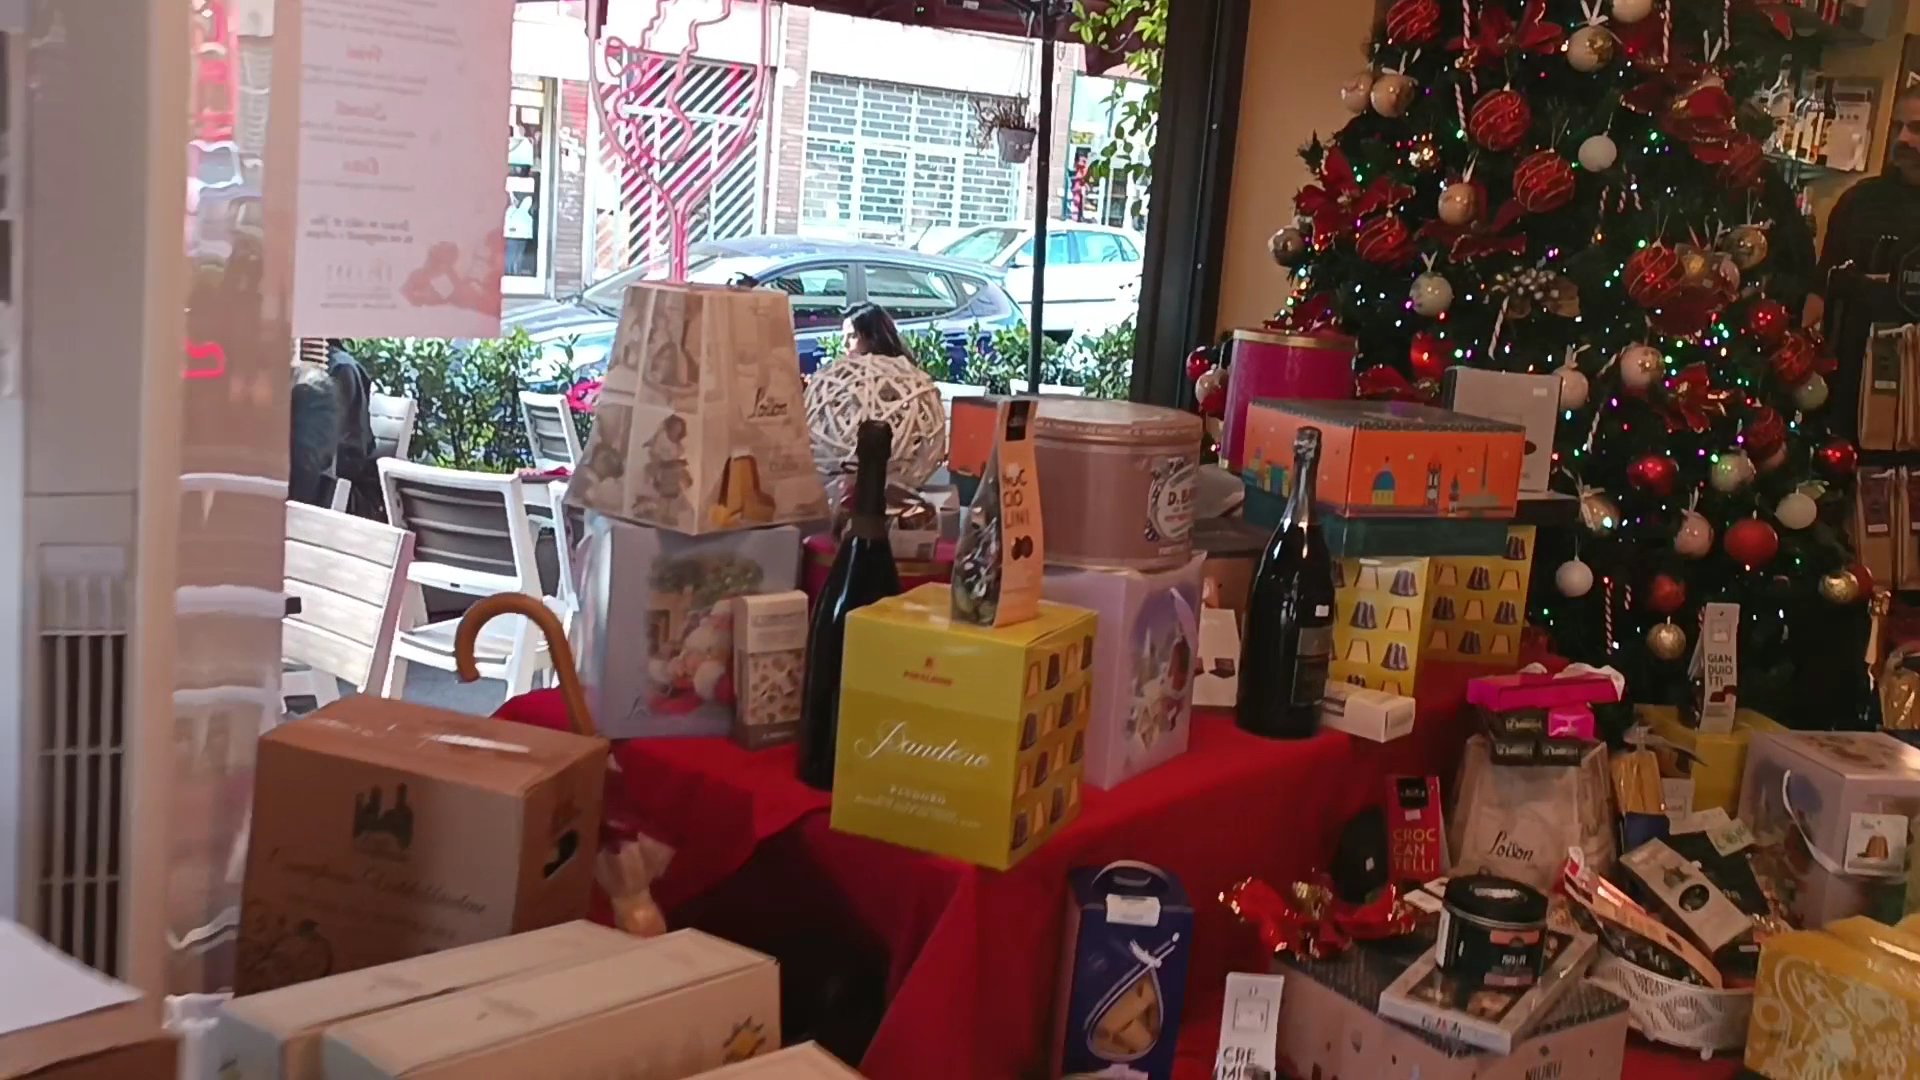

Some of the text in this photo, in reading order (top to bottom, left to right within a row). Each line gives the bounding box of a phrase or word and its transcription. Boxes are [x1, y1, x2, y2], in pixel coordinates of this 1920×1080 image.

[1707, 653, 1732, 663] GIAN
[1708, 676, 1723, 687] TTI
[1393, 828, 1437, 842] CROC
[1393, 842, 1425, 857] CAN
[1394, 857, 1435, 874] TELLI
[1223, 1046, 1256, 1064] CRE
